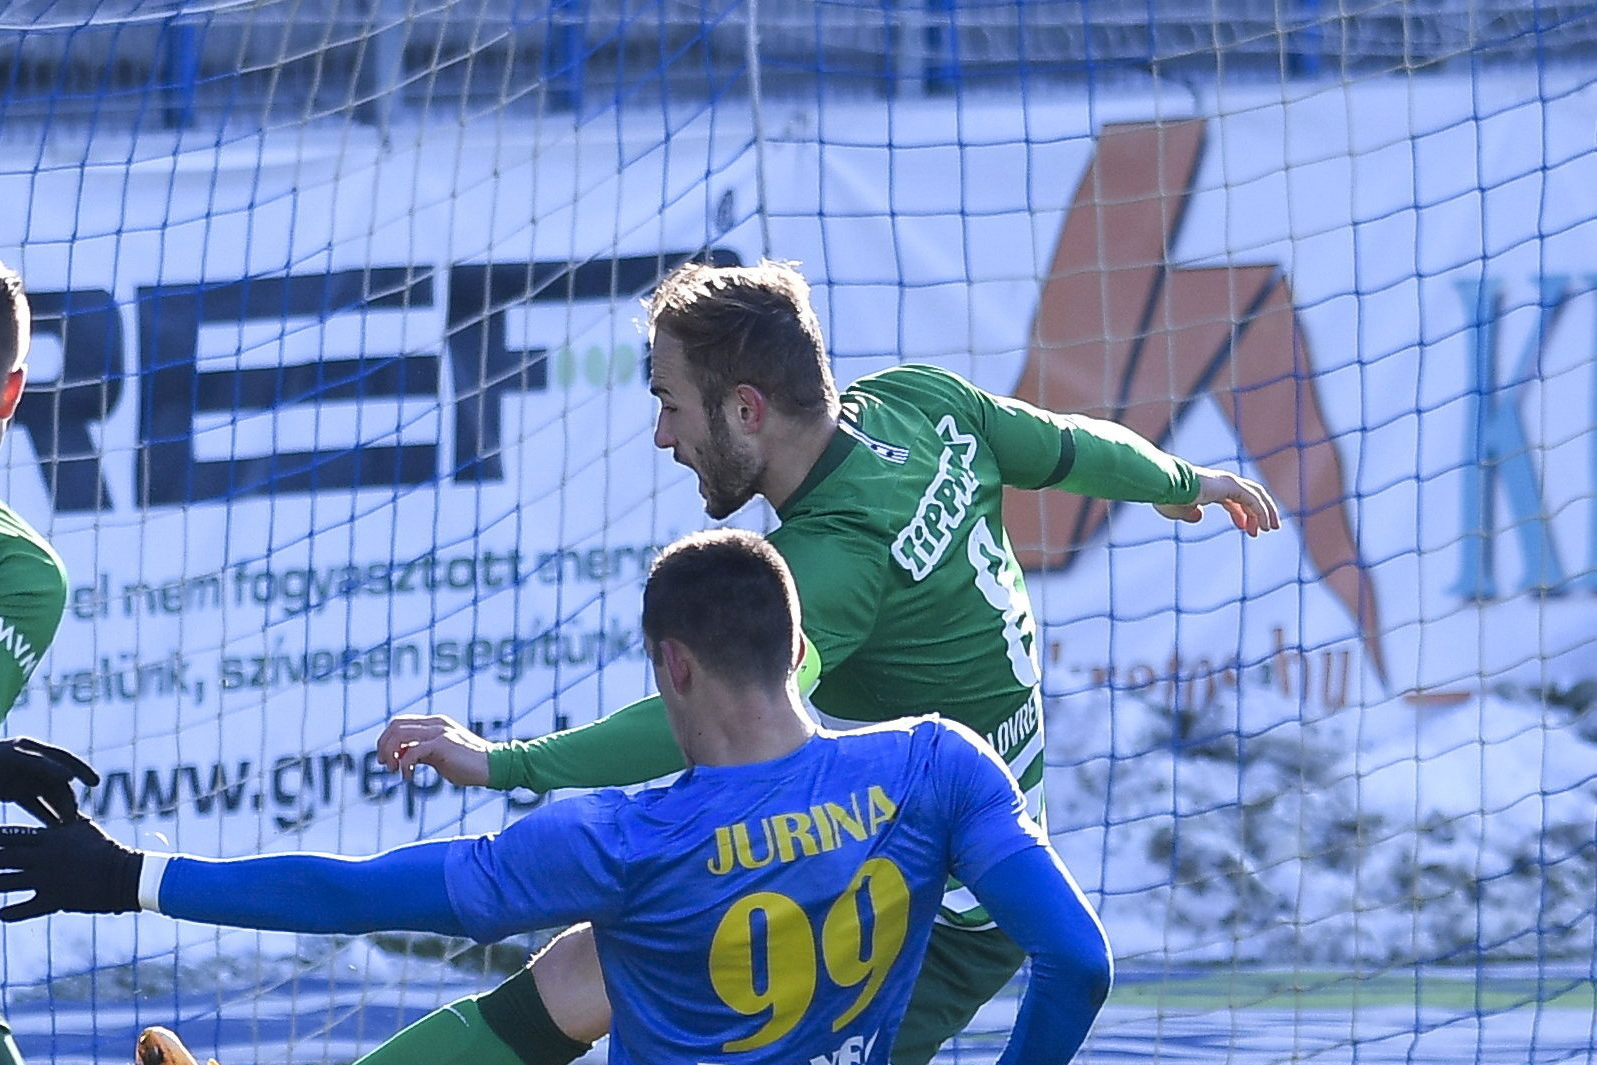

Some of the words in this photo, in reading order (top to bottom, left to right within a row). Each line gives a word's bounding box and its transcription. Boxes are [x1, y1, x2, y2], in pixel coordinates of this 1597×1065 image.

[1445, 272, 1597, 602] K
[122, 574, 221, 618] nem
[233, 549, 521, 616] fogyasztott
[220, 634, 420, 693] szívesen
[707, 785, 898, 876] JURINA
[708, 857, 911, 1054] 99
